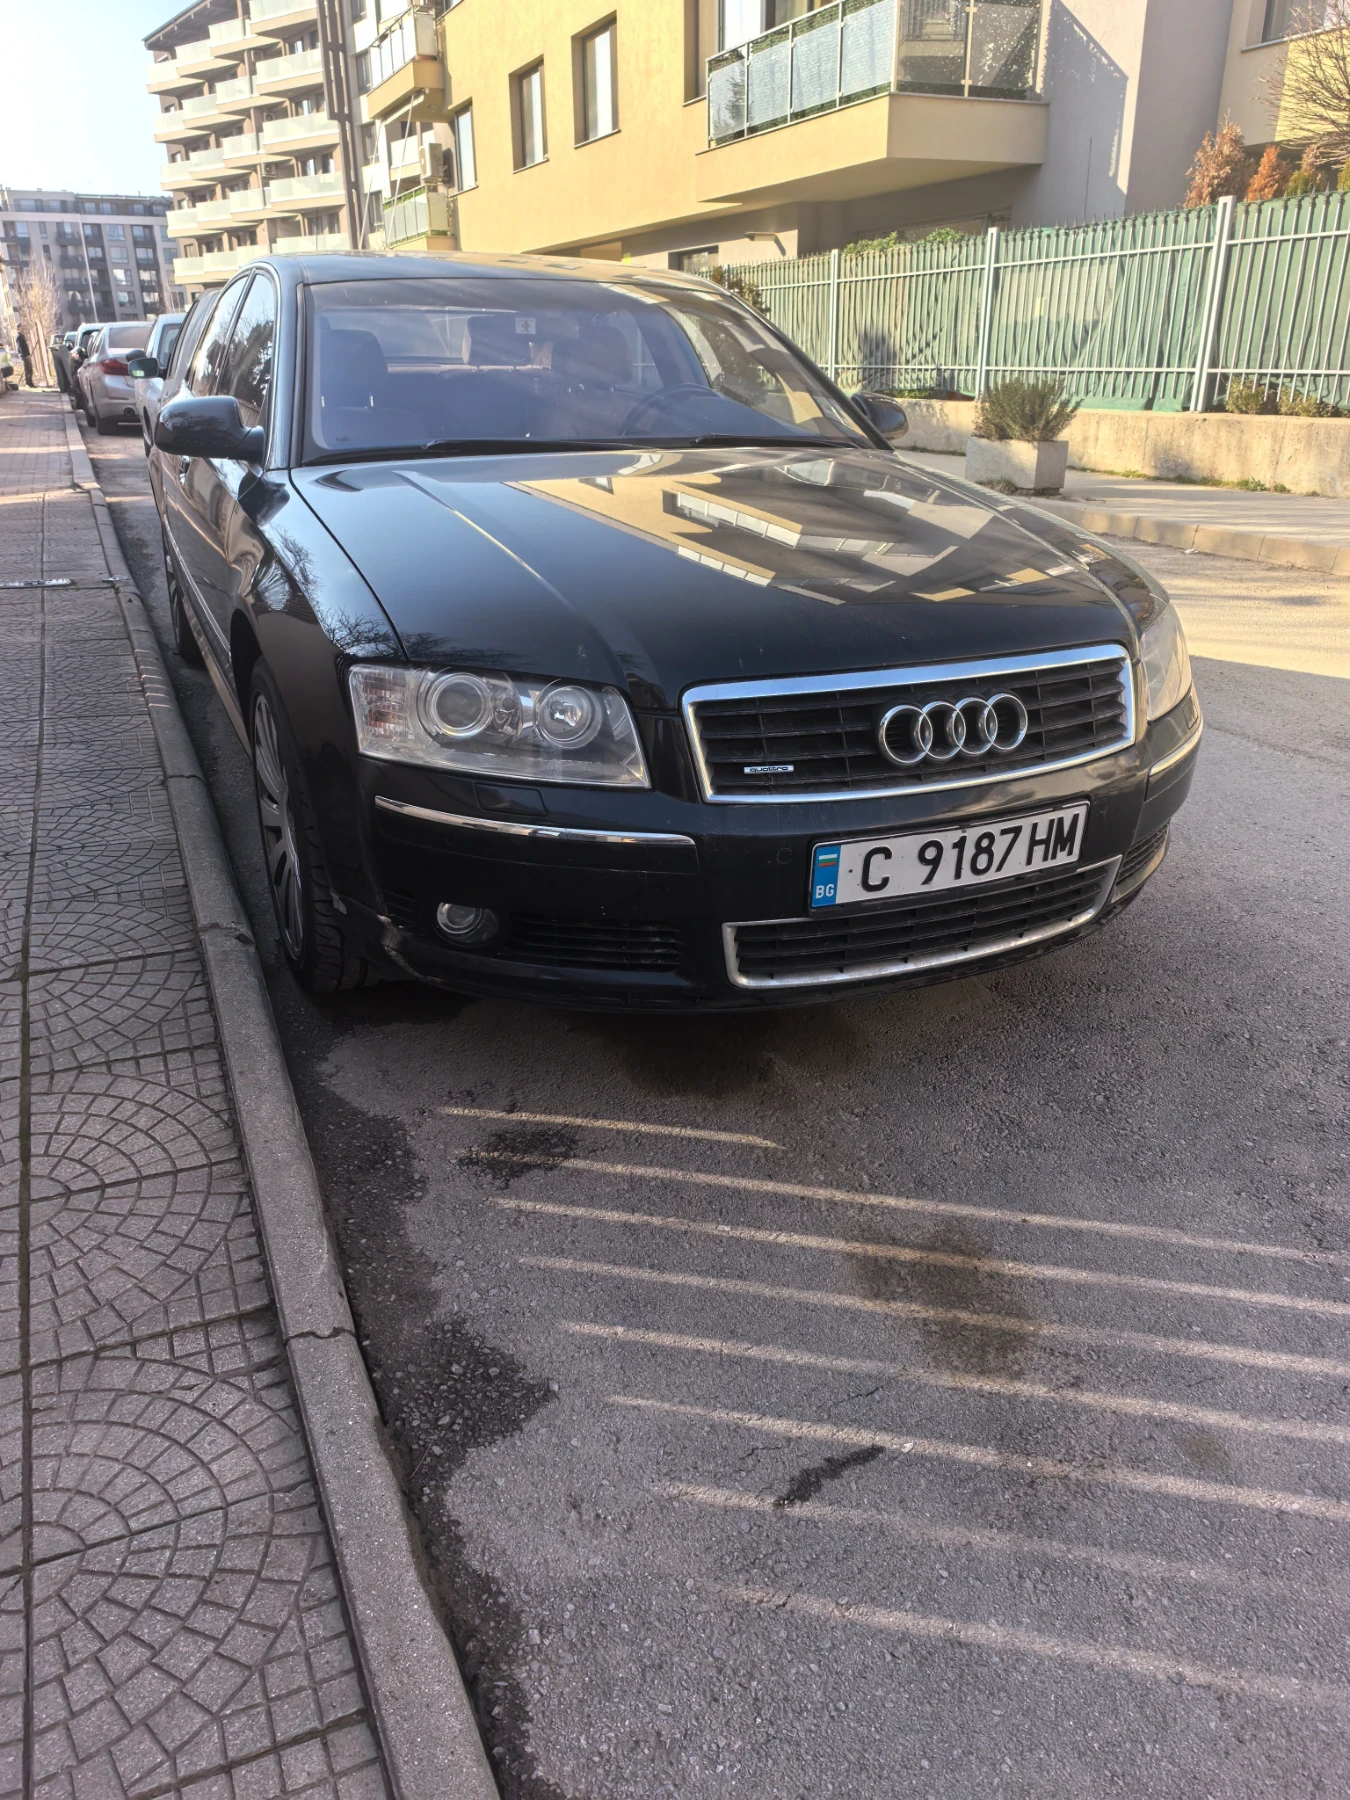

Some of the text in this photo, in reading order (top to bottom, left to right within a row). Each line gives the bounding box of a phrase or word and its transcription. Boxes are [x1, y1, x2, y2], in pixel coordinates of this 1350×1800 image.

[860, 846, 893, 893] C
[917, 825, 1023, 886] 9187
[815, 883, 835, 899] BG
